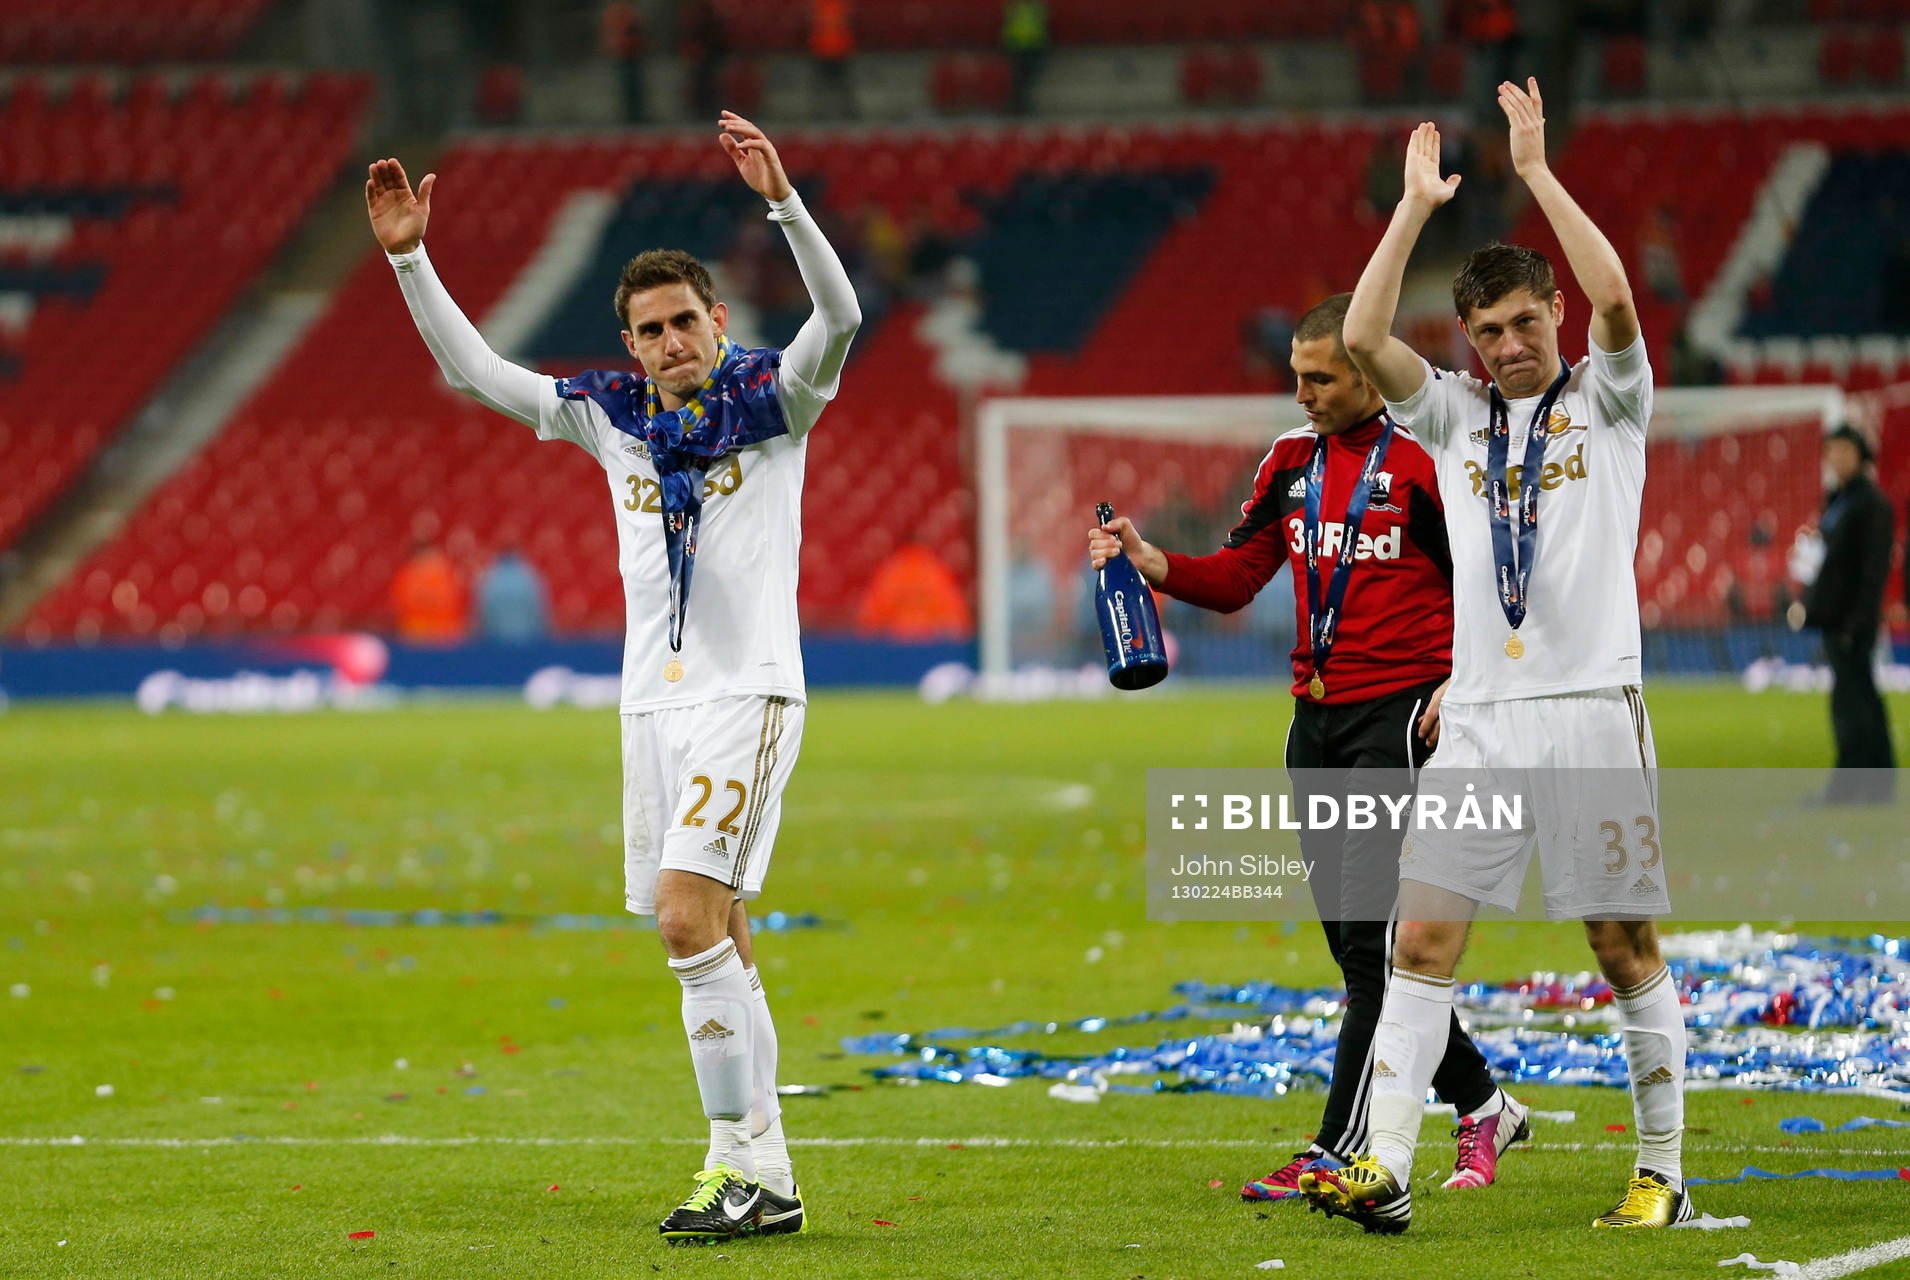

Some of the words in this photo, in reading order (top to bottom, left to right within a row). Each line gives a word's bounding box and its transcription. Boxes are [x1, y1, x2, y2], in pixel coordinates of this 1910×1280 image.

[1470, 434, 1490, 447] adida
[623, 456, 743, 514] 32ed
[1288, 490, 1306, 498] adida
[680, 774, 747, 838] 22
[702, 844, 730, 860] adidas
[1599, 814, 1661, 875] 33
[690, 1028, 735, 1041] adidas
